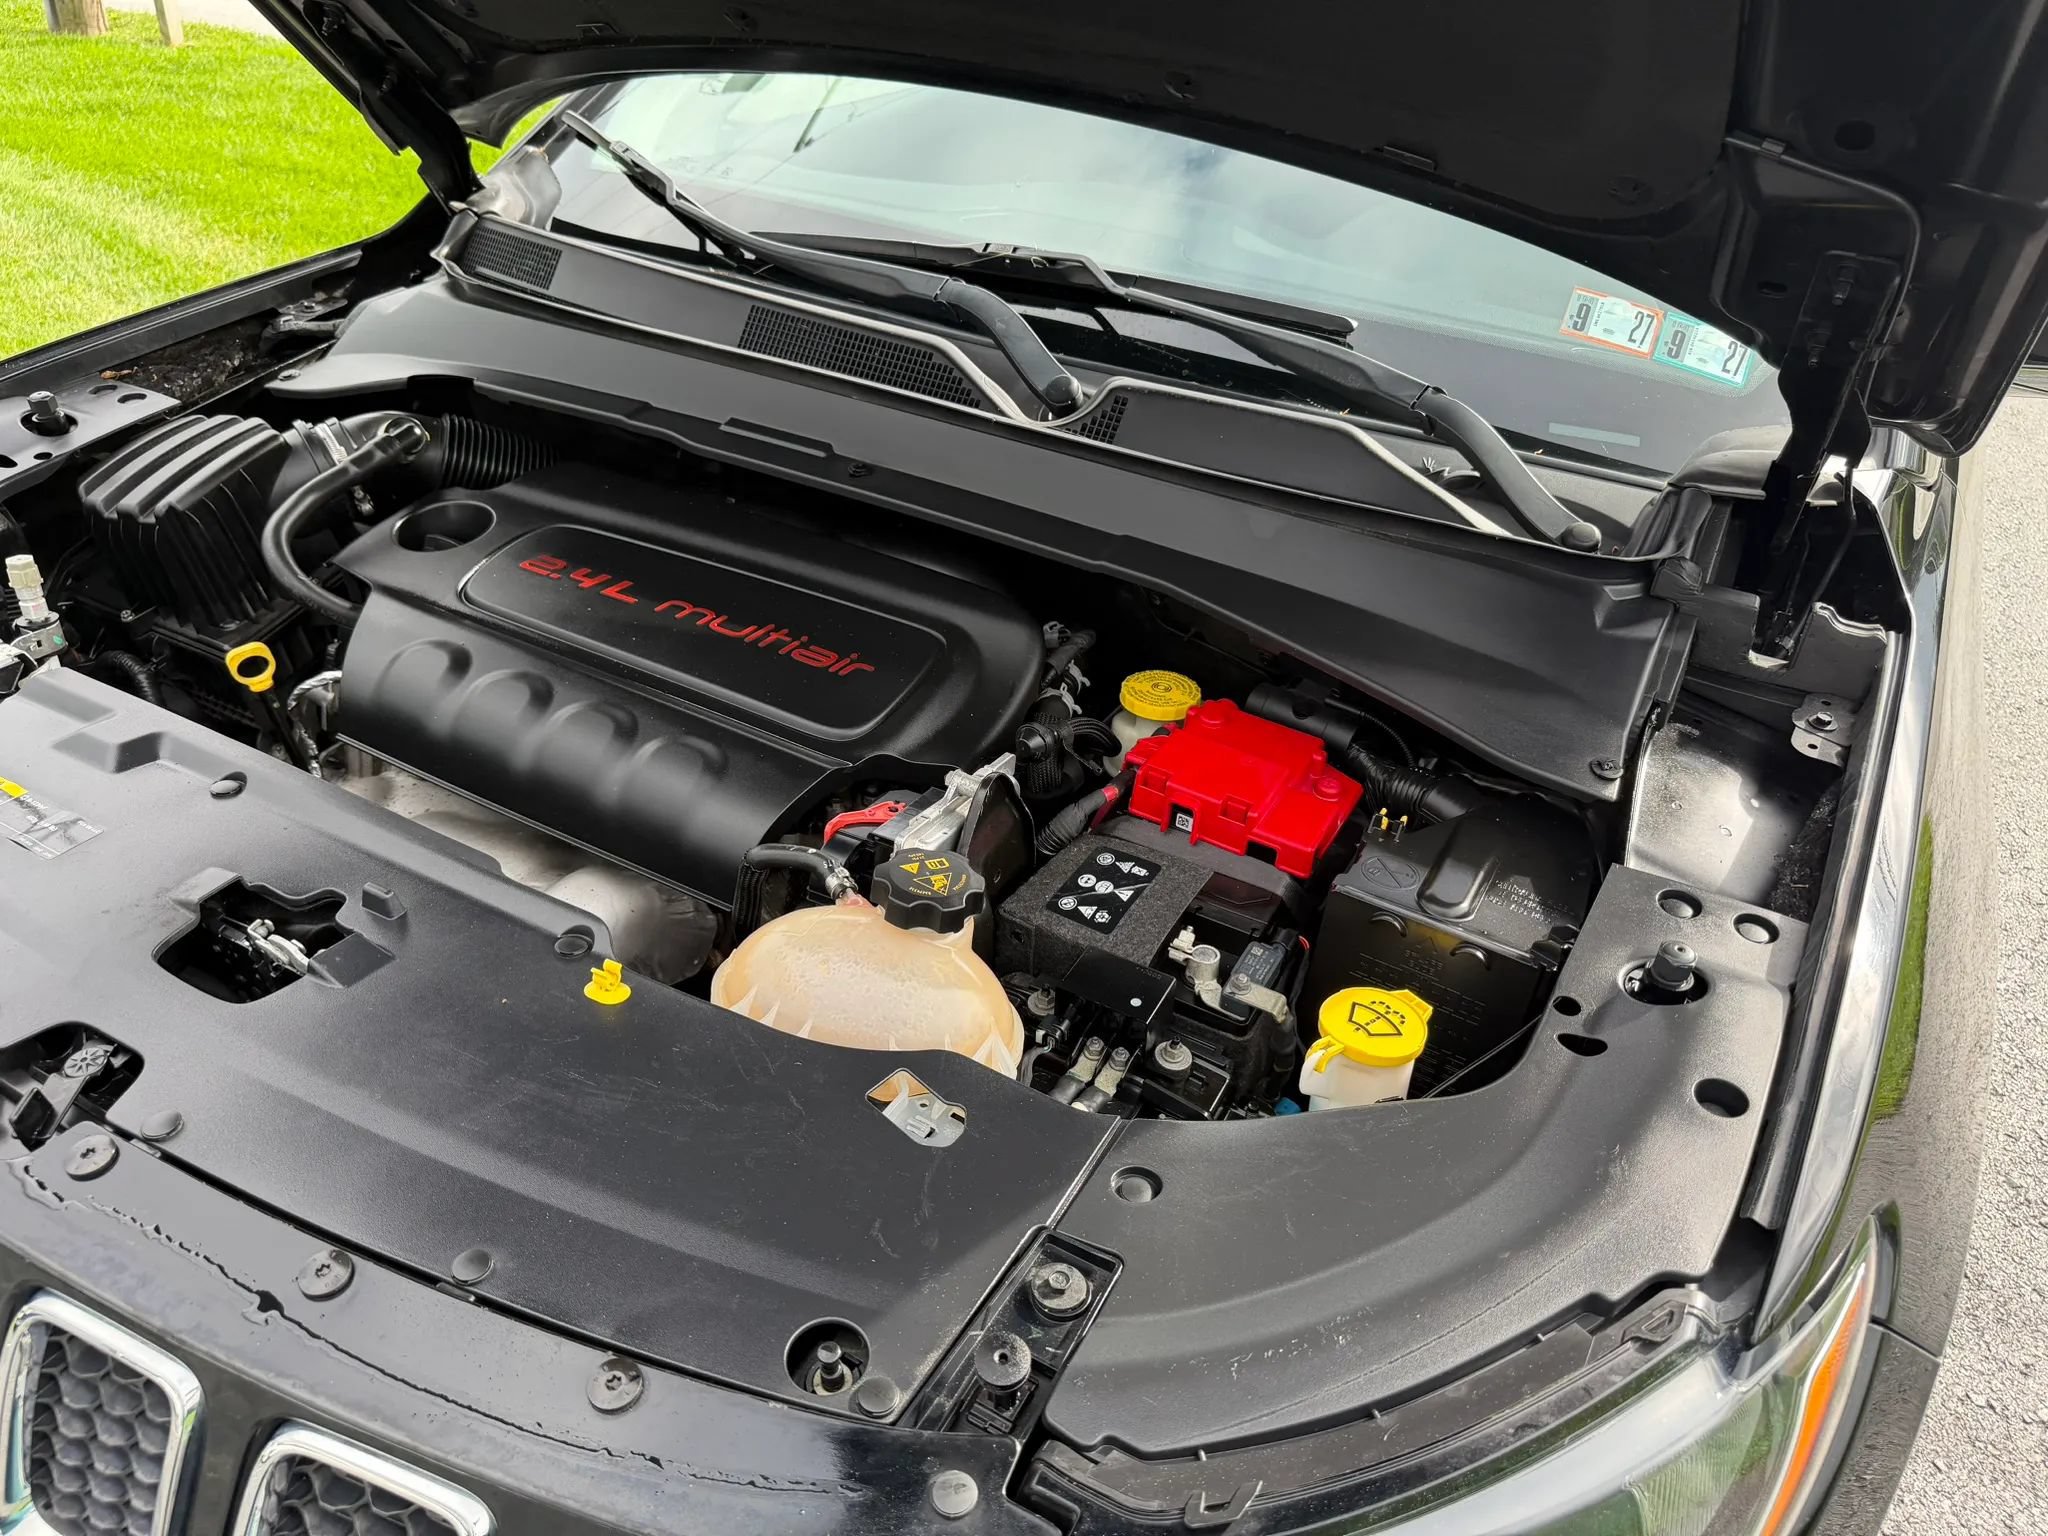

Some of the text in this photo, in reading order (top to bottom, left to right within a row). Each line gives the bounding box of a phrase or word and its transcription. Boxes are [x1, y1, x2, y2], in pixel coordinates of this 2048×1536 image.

[1572, 303, 1591, 332] 9
[1628, 310, 1655, 346] 27
[1667, 330, 1686, 360] 9
[1722, 340, 1749, 376] 27
[519, 554, 875, 676] 2.4L multiair
